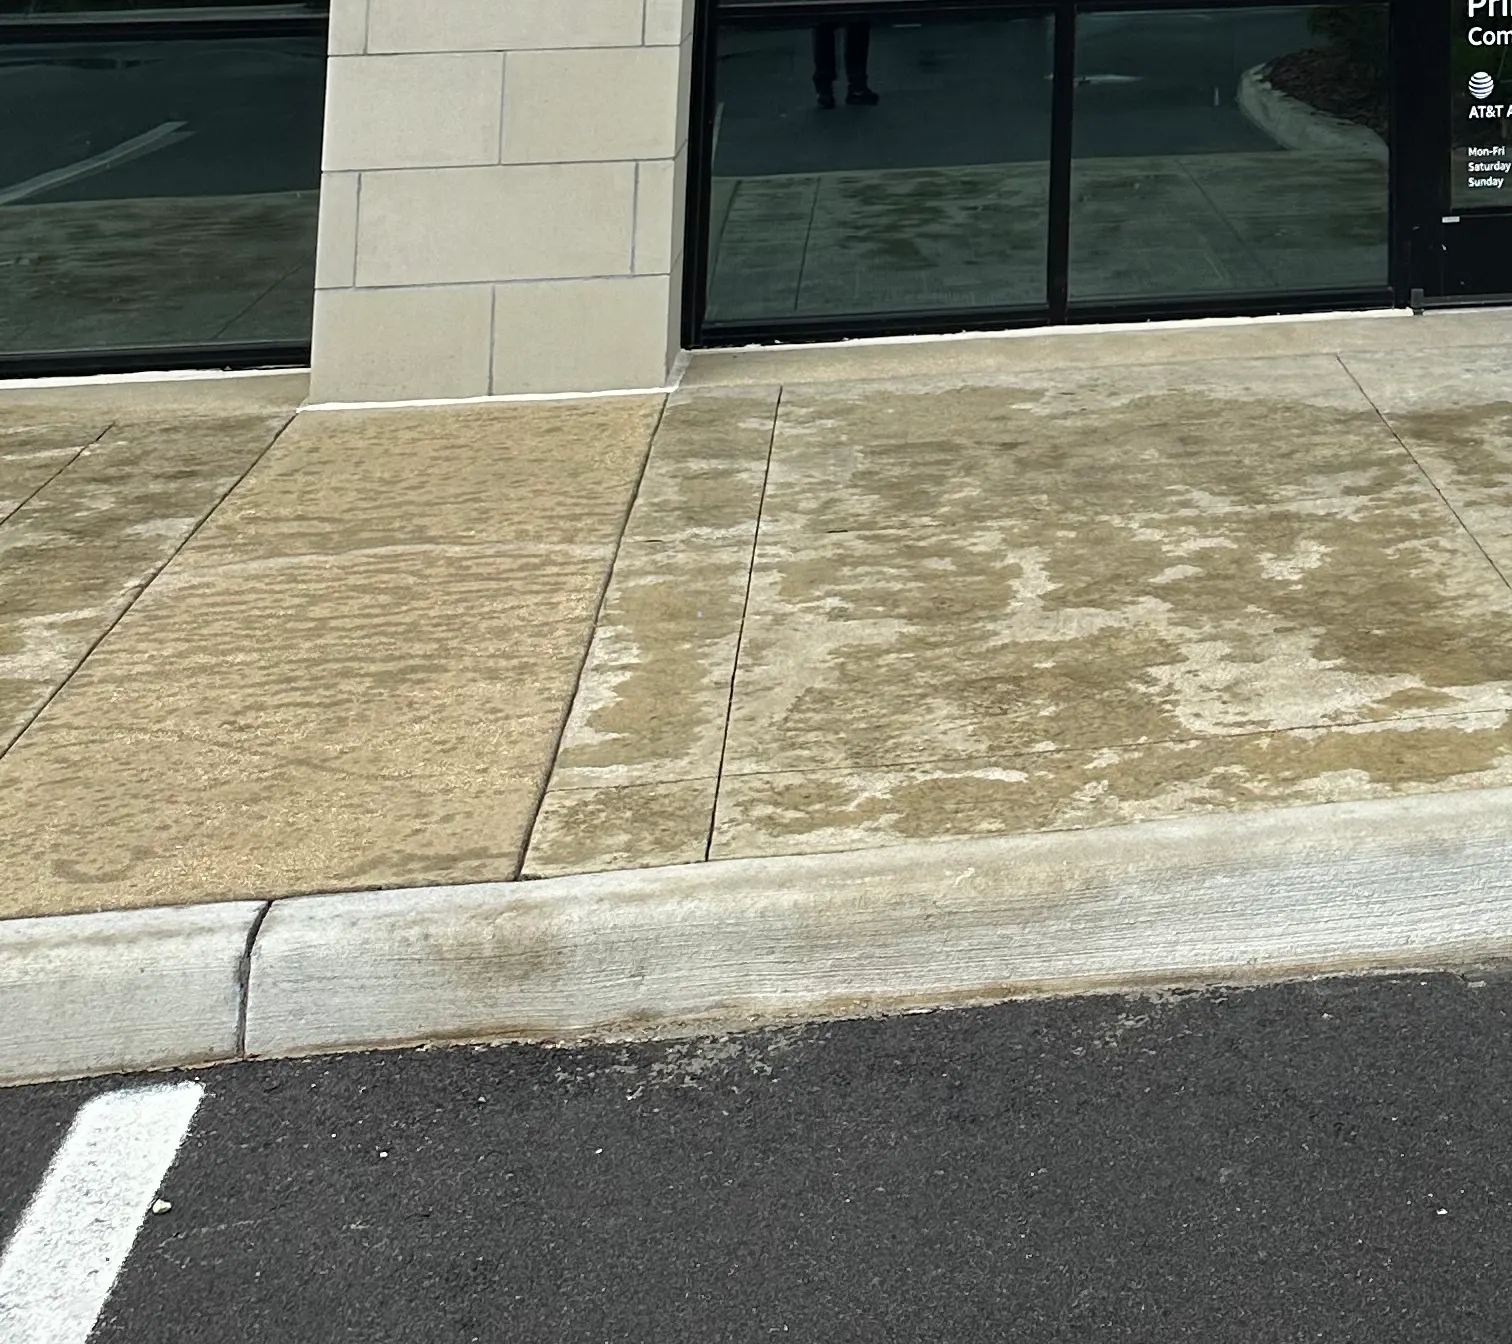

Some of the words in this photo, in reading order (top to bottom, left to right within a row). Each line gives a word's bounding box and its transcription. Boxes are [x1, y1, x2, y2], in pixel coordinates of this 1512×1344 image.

[1468, 104, 1504, 119] AT&T
[1468, 145, 1506, 157] Mon-Fri
[1468, 160, 1512, 173] Saturday
[1468, 176, 1504, 189] Sunday
